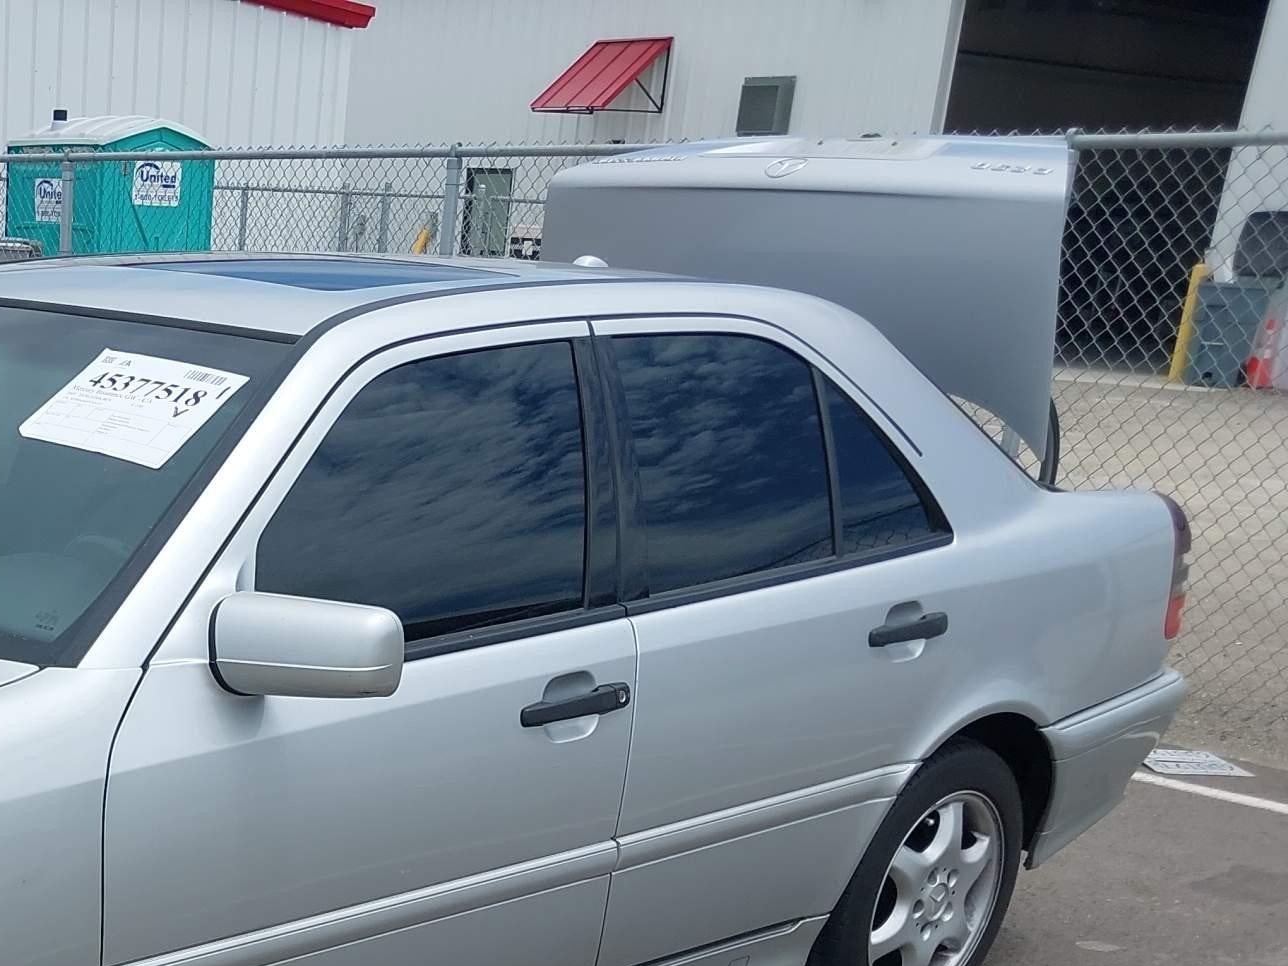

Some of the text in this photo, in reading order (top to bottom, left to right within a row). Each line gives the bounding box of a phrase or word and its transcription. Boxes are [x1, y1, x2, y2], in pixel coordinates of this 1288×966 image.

[140, 169, 178, 184] United
[39, 186, 62, 200] Unite
[88, 371, 208, 407] 45377518
